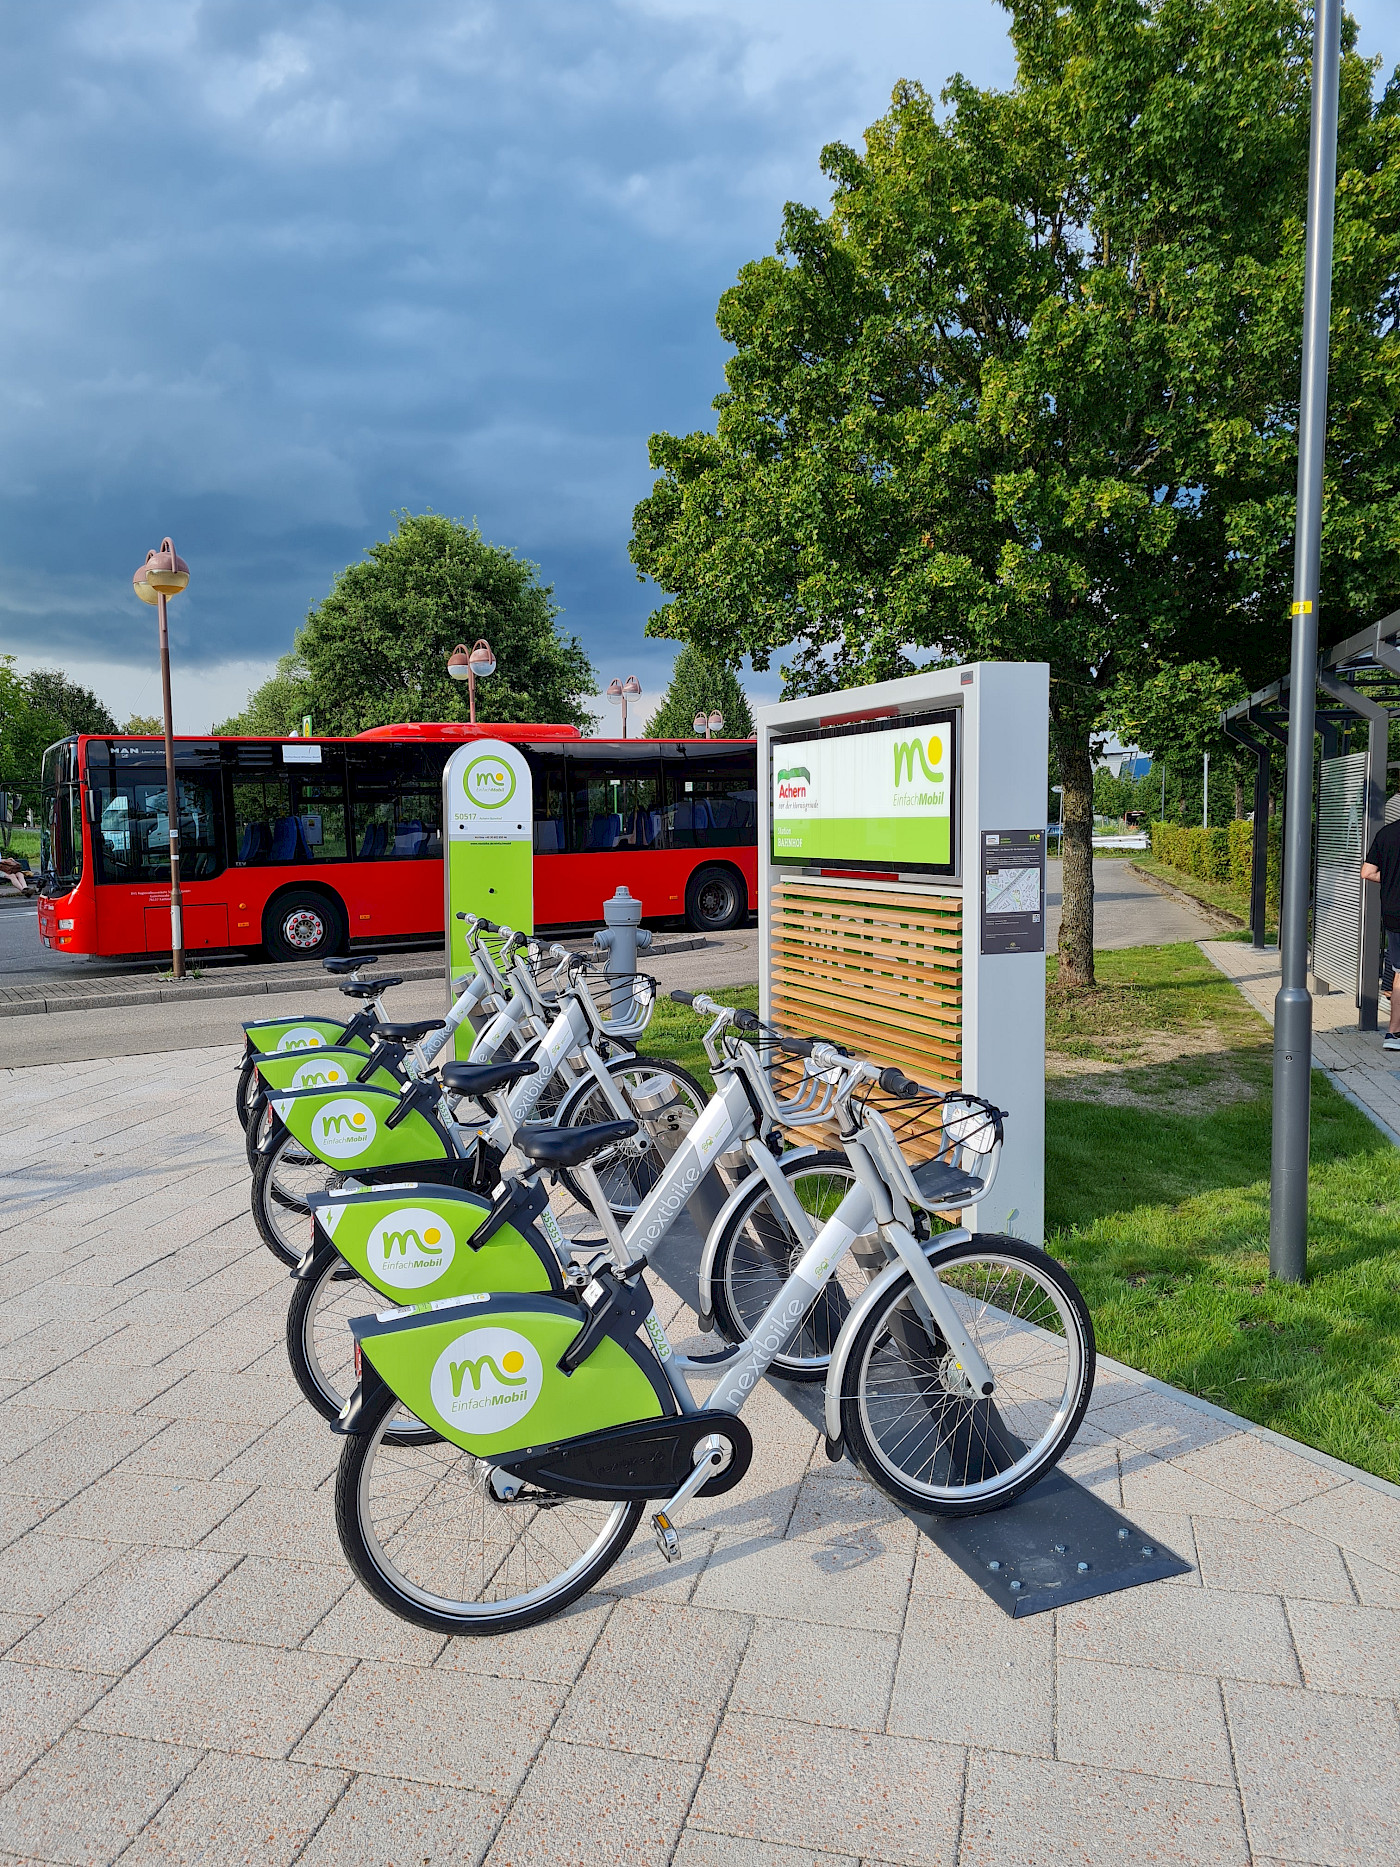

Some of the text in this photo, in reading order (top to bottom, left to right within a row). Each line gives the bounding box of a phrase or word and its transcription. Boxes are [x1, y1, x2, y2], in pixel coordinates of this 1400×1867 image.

[779, 784, 807, 799] Achern
[893, 791, 945, 808] EinfachMobil
[777, 838, 803, 848] BAHNHOF
[322, 1134, 368, 1146] EinfachMobil
[637, 1166, 701, 1254] nextbike
[541, 1211, 562, 1243] 355351
[382, 1258, 443, 1271] EinfachMobil
[645, 1315, 670, 1357] 355243
[725, 1297, 805, 1408] nextbike
[450, 1389, 528, 1413] EinfachMobil
